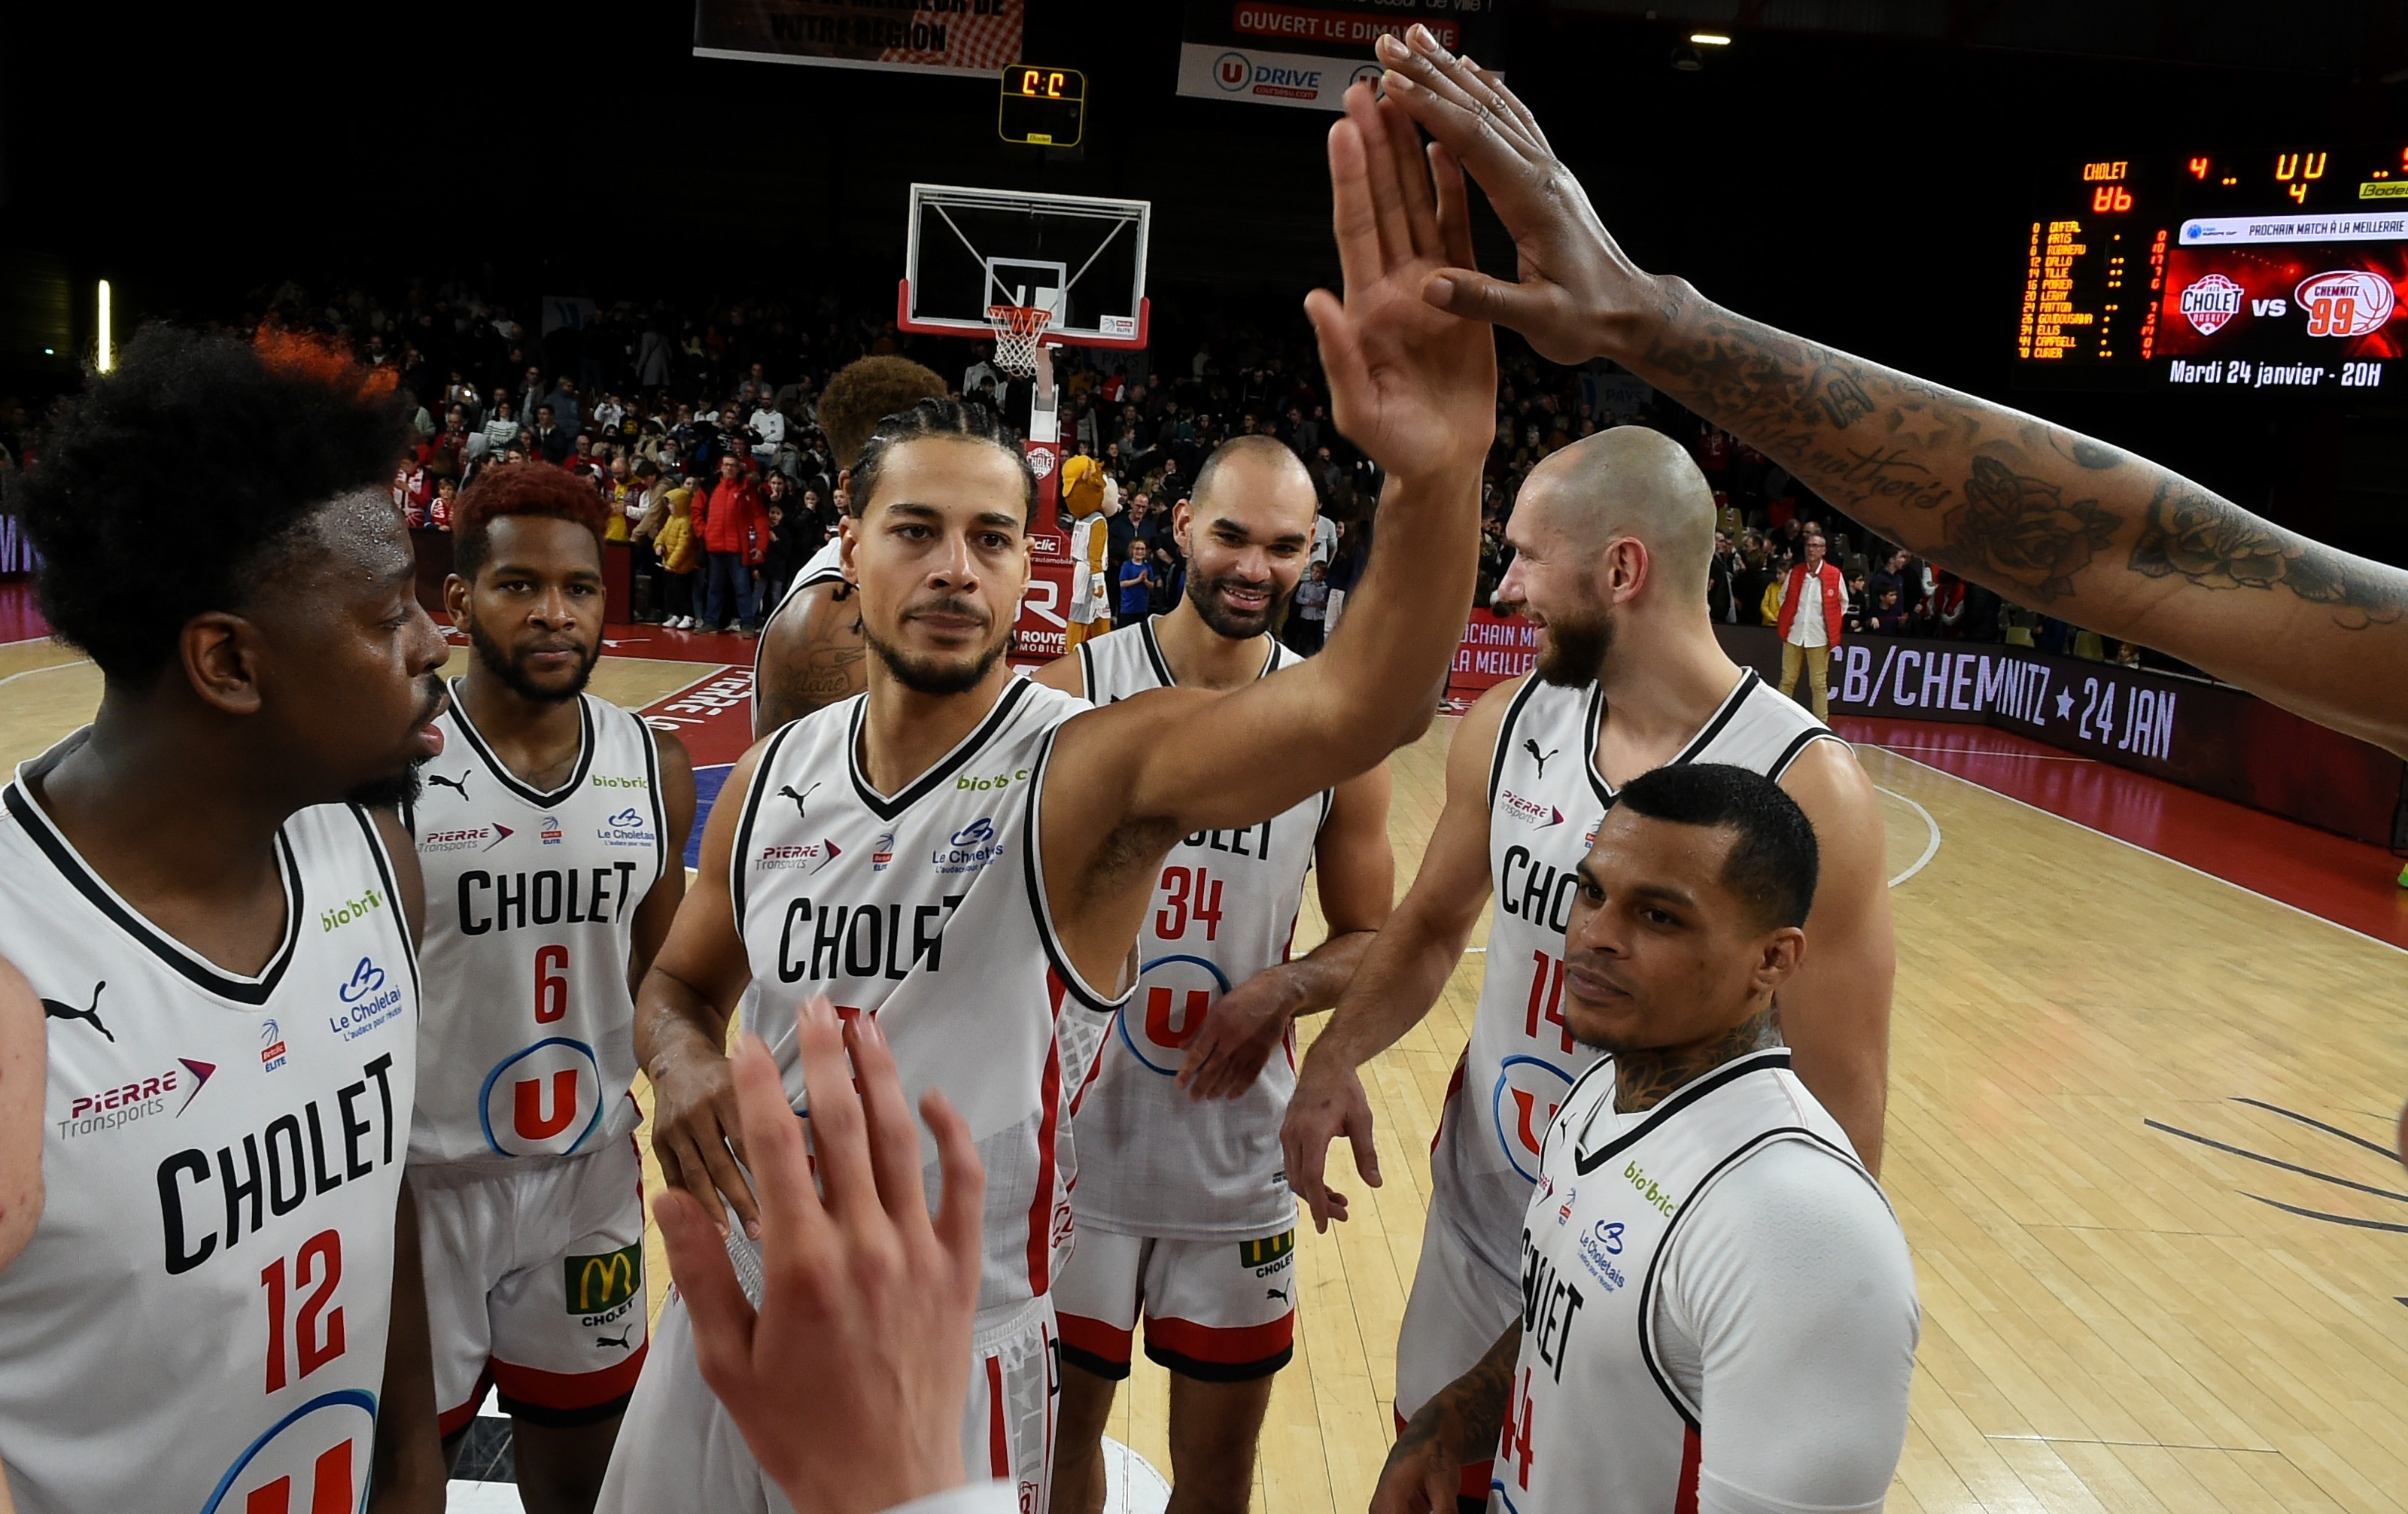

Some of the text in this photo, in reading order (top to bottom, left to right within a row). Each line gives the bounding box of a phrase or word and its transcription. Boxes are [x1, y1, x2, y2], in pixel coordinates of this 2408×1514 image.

[771, 13, 849, 43] VOTRE
[1239, 11, 1455, 46] OUVERT LE DIMAHE
[1254, 65, 1322, 88] DRIVE
[2084, 161, 2128, 181] CHOLET
[2189, 157, 2208, 179] 4
[2289, 183, 2307, 204] 4
[2249, 223, 2294, 236] PROCHAIN
[2297, 222, 2327, 235] MATCH
[2340, 222, 2350, 233] LA
[2353, 220, 2406, 233] MEILLERAIE
[2182, 288, 2244, 312] CHOLET
[2314, 286, 2360, 297] CHEMNITZ
[2036, 325, 2060, 336] ELLIS
[2309, 298, 2355, 336] 99
[2169, 360, 2223, 384] Mardi
[2227, 360, 2251, 385] 24
[2254, 361, 2324, 388] janvier
[2340, 363, 2382, 387] 20H
[1035, 538, 1057, 551] clic
[1019, 643, 1069, 655] MOBILE
[1021, 631, 1066, 645] ROUYE
[2079, 676, 2116, 744] 24
[2118, 686, 2176, 762] JAN
[592, 775, 649, 789] bio'bric
[419, 840, 479, 853] Transports
[597, 829, 610, 838] Le
[932, 850, 946, 864] Le
[458, 861, 637, 935] CHOLET
[1155, 865, 1223, 941] 34
[1502, 844, 1579, 935] CHO
[321, 889, 383, 933] bio'bri
[534, 944, 568, 1024] 6
[330, 983, 402, 1033] Le Choletai
[1525, 949, 1574, 1055] 14
[57, 1098, 164, 1140] Transports
[156, 1051, 393, 1275] CHOLET
[1624, 1160, 1674, 1218] bio'bric
[1256, 1252, 1294, 1278] CHOLET
[260, 1228, 345, 1395] 12
[582, 1297, 634, 1327] CHOLET
